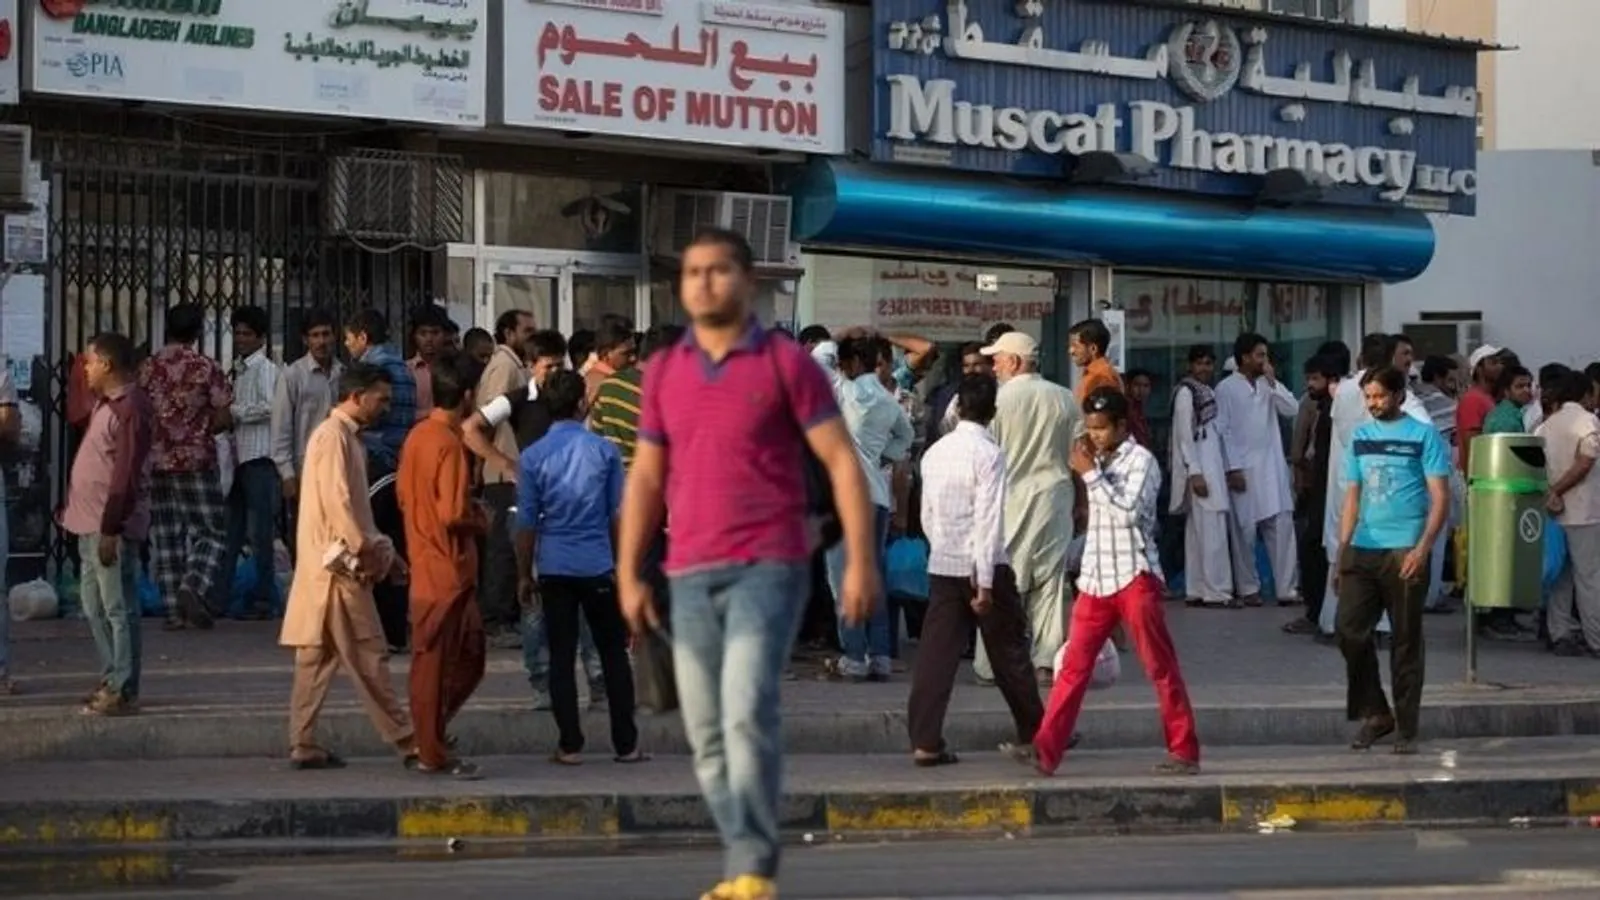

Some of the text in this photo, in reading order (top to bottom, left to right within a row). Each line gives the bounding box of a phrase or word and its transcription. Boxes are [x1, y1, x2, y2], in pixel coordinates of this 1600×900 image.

[73, 12, 256, 50] BANGLADESH AIRLINES
[91, 52, 124, 78] PIA
[538, 21, 818, 94] بيع اللحوم
[944, 0, 1168, 79] مسقط
[538, 75, 818, 136] SALE OF MUTTON
[1239, 26, 1476, 135] صيدلية
[885, 74, 1122, 155] Muscat
[1130, 101, 1417, 200] Pharmacy
